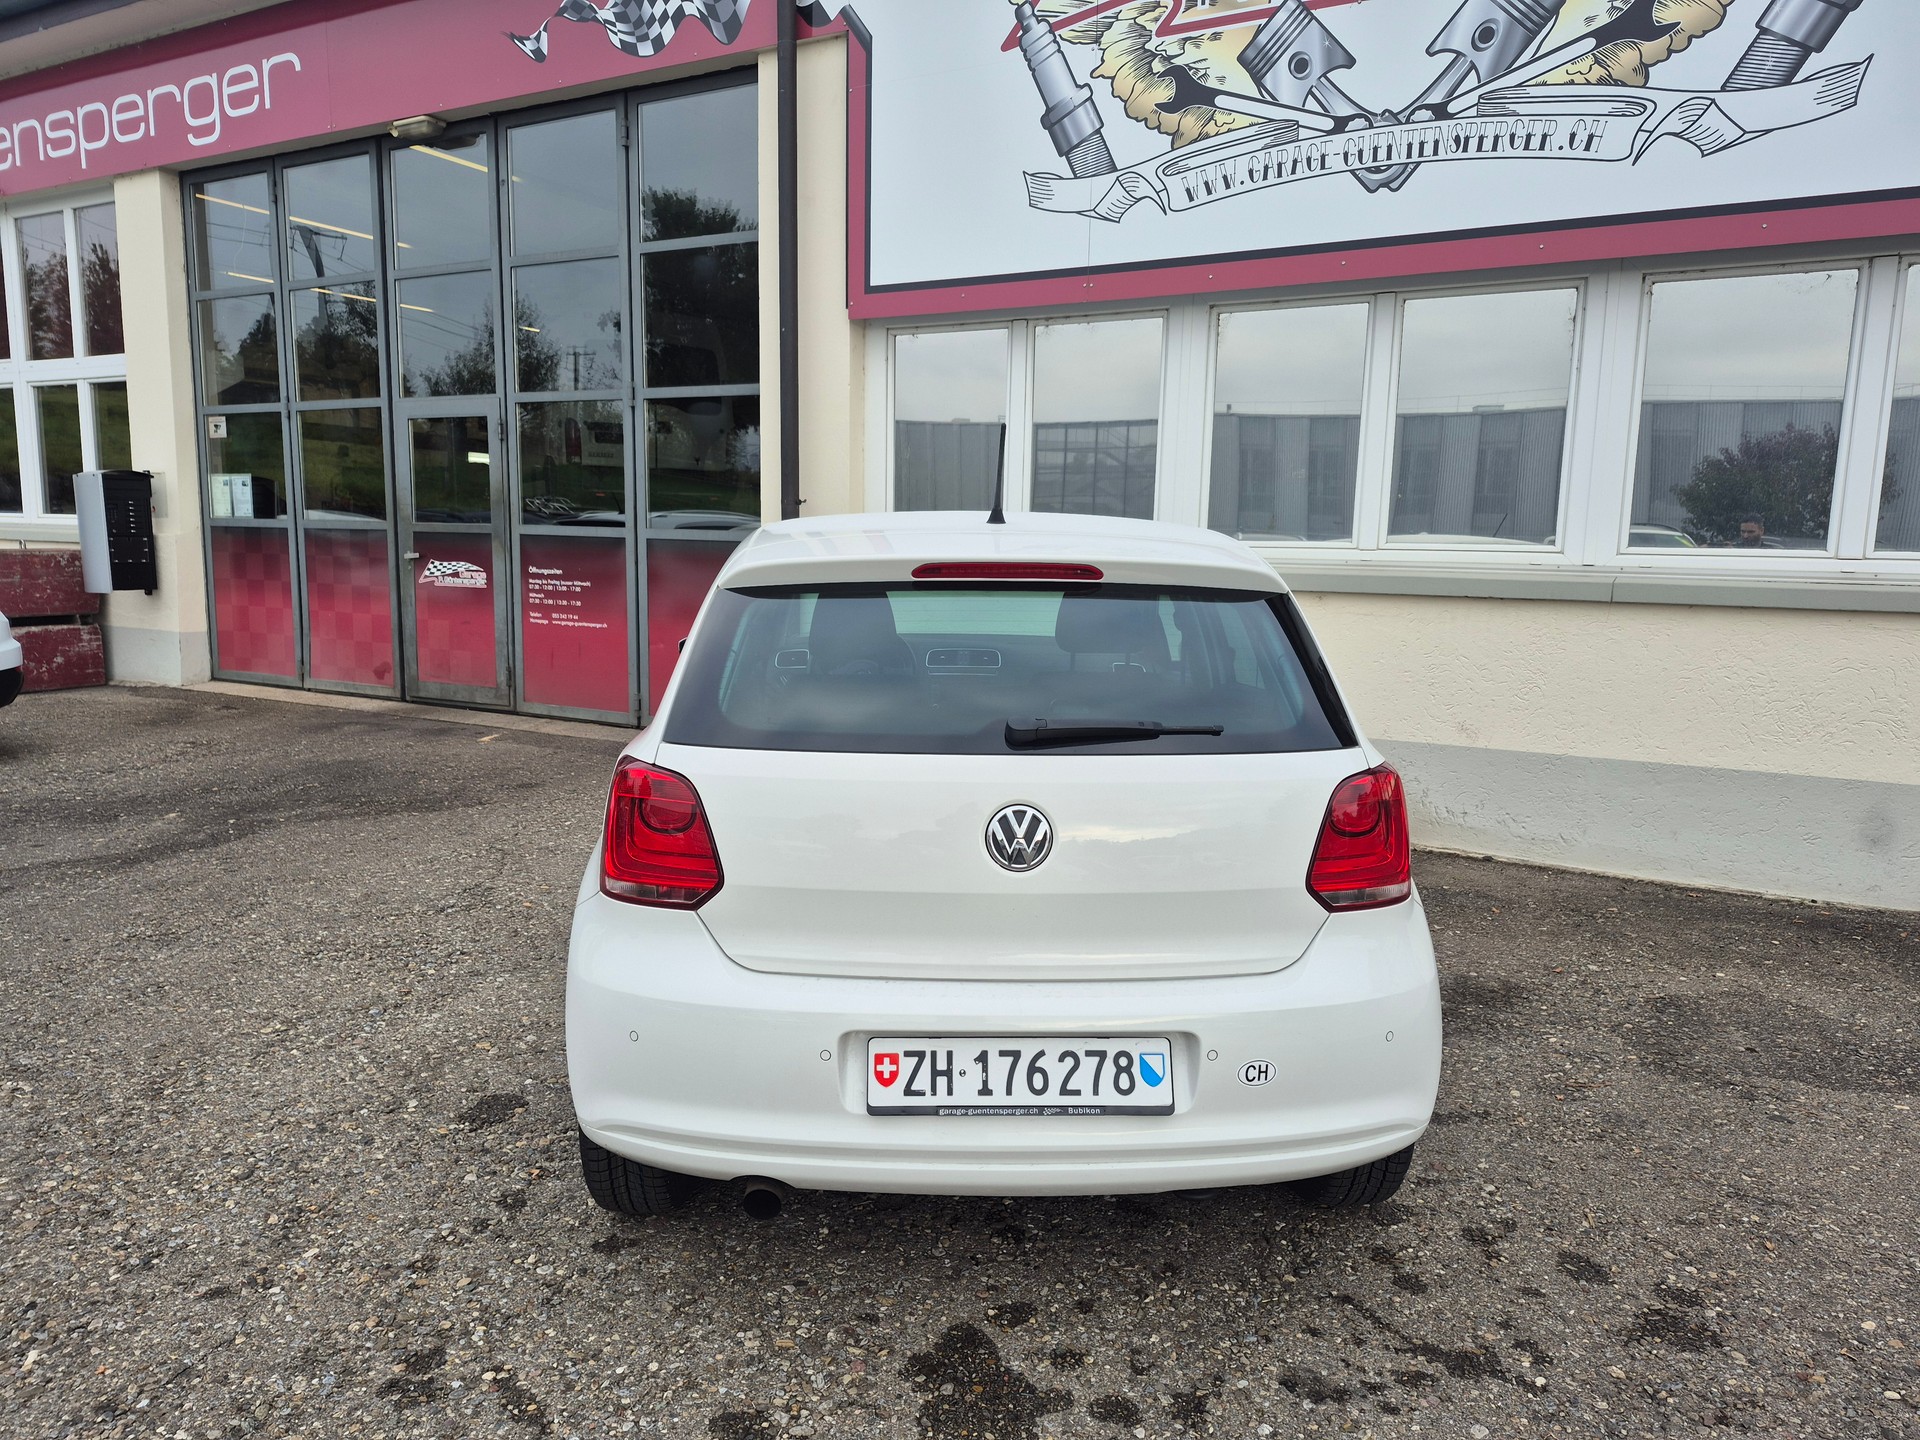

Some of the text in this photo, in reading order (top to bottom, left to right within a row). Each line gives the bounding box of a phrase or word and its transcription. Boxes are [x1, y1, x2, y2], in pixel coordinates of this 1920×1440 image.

[1181, 119, 1609, 204] WWW.GARAGE-GUENTENSPERGER.CH
[529, 565, 563, 575] Öffnungszeiten
[903, 1049, 1136, 1096] ZH 176278
[1245, 1063, 1269, 1083] CH
[939, 1107, 1039, 1116] garage-guentensperger.ch
